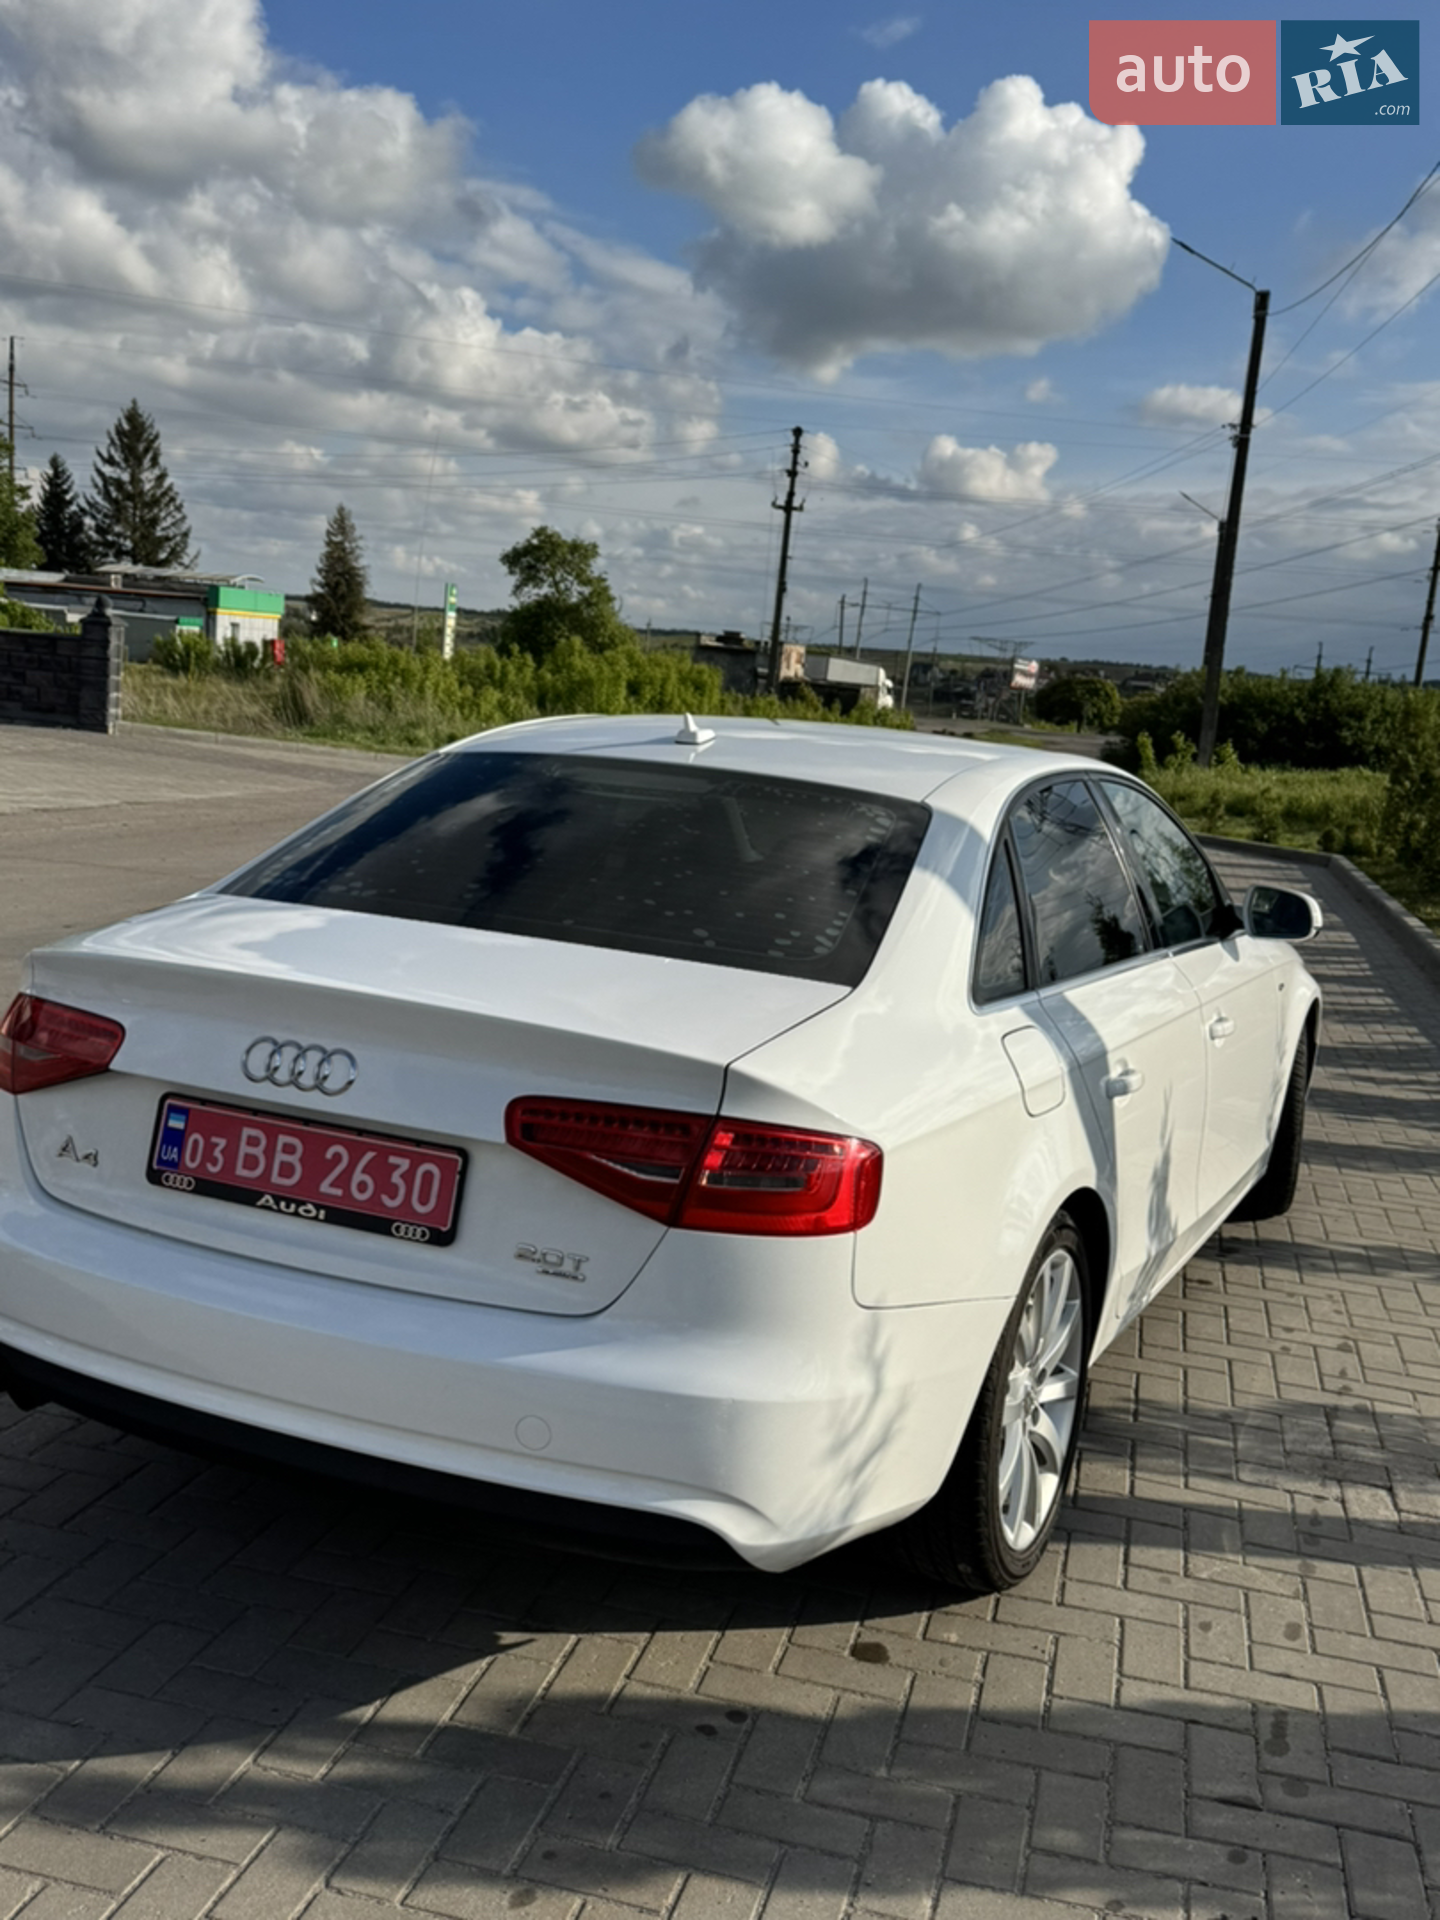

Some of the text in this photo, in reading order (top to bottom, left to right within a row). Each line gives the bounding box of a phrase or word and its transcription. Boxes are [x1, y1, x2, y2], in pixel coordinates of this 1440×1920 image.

[56, 1134, 100, 1169] A4
[161, 1144, 179, 1163] UA
[184, 1126, 441, 1214] 03 BB 2630
[256, 1194, 326, 1221] Audi
